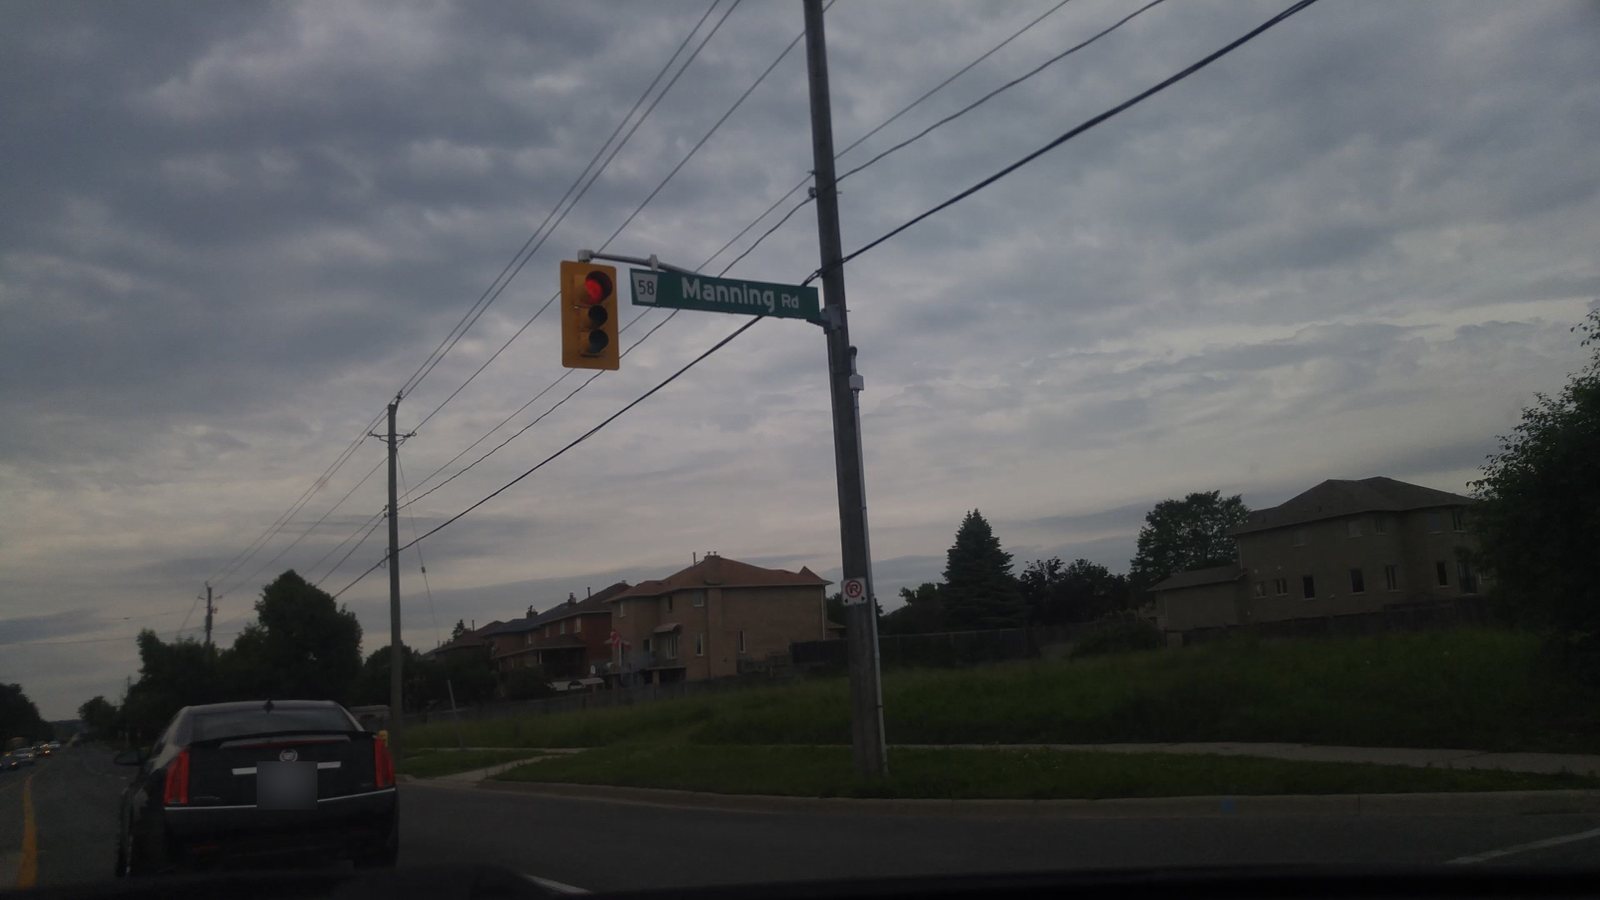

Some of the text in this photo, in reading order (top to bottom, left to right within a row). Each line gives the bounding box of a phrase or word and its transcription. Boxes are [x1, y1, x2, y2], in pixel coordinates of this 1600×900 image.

[638, 280, 655, 296] 58
[681, 276, 800, 313] Manning Rd
